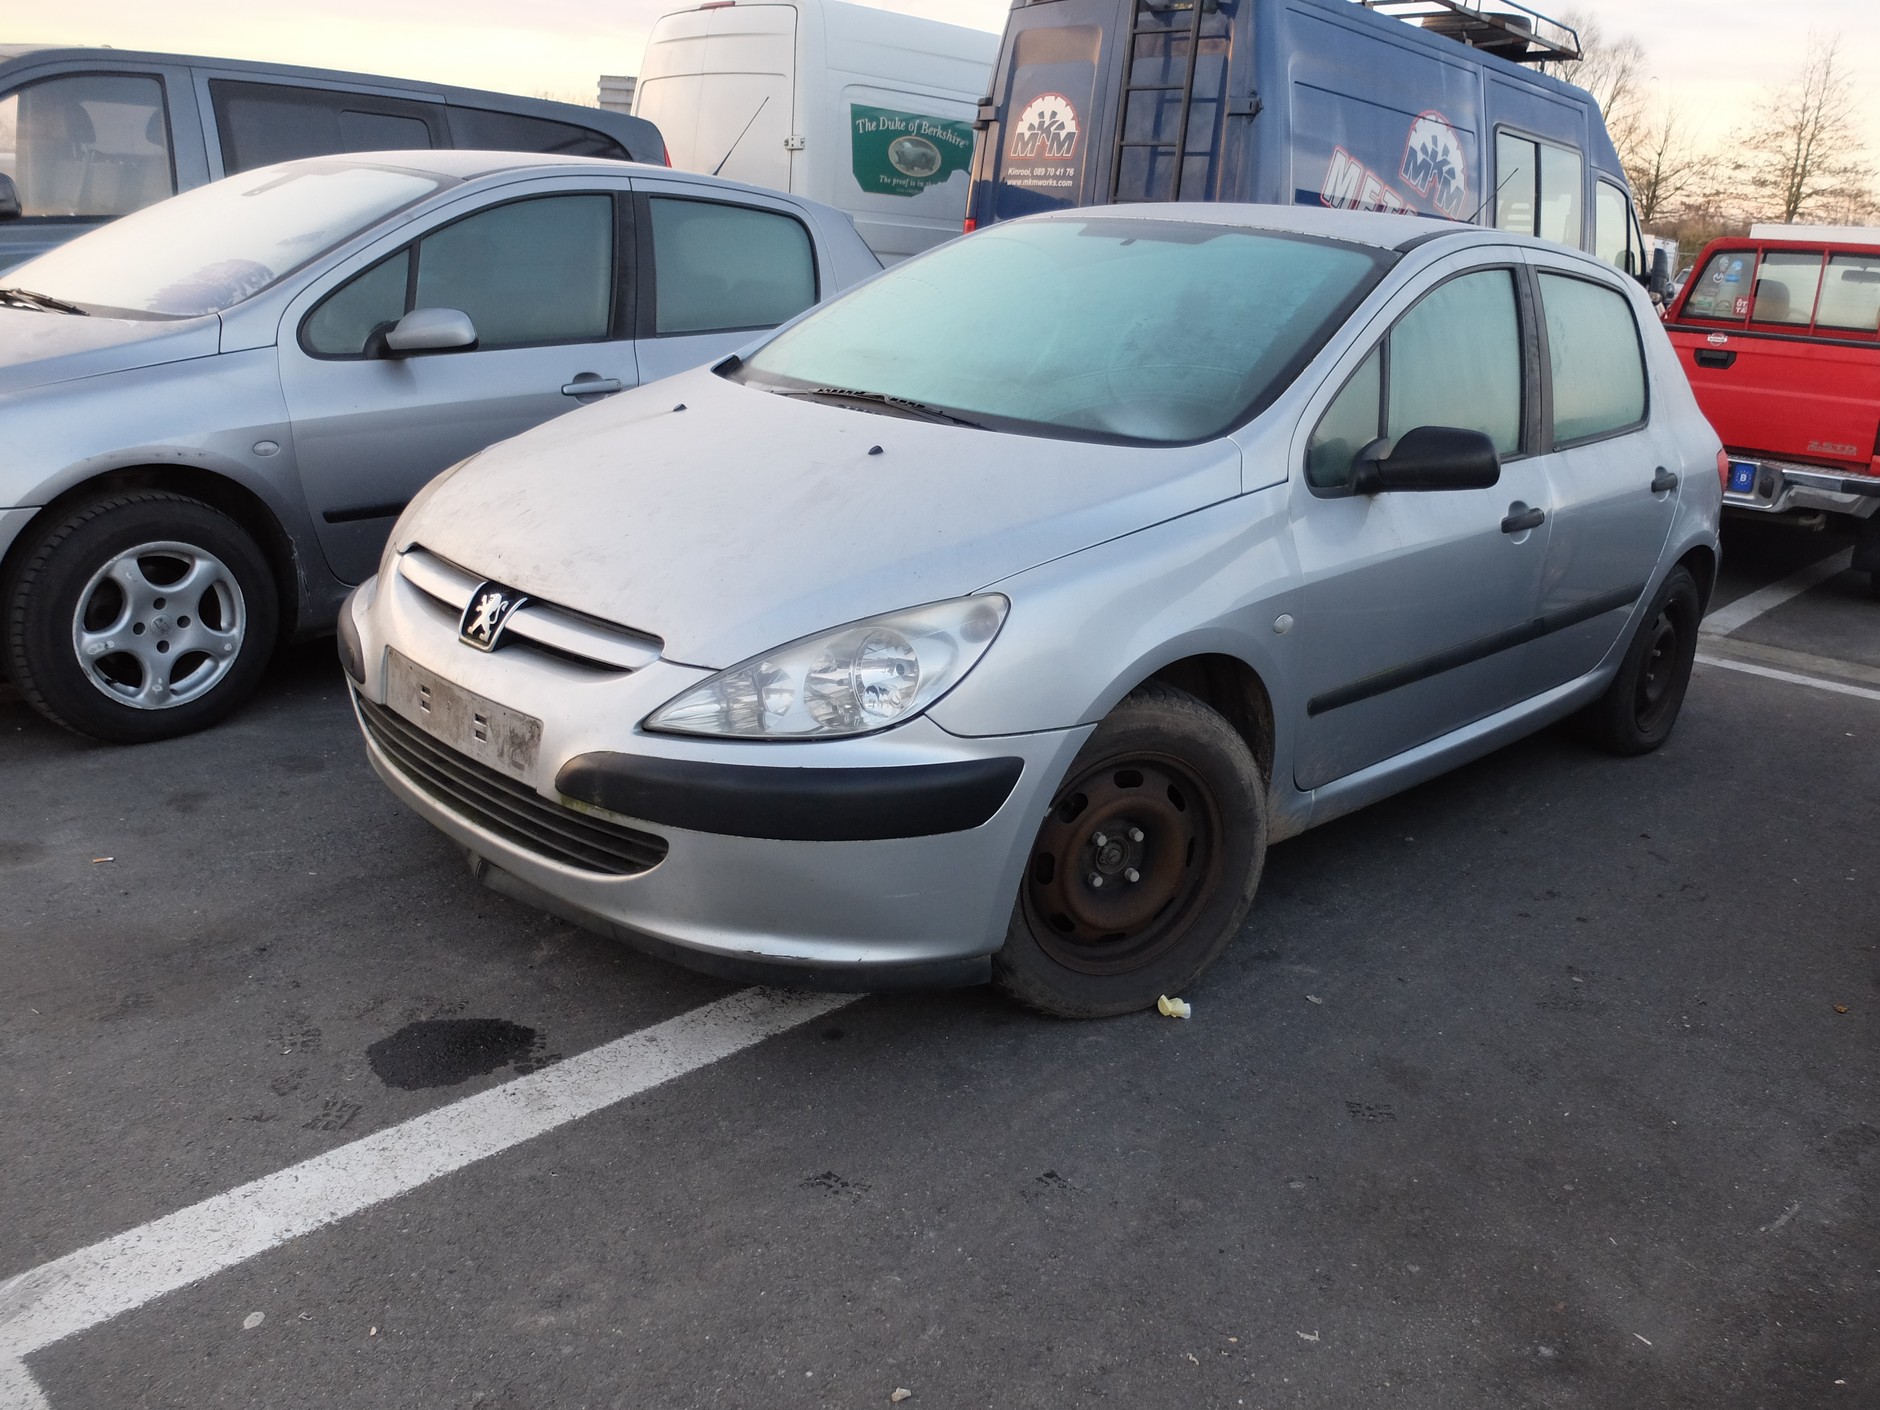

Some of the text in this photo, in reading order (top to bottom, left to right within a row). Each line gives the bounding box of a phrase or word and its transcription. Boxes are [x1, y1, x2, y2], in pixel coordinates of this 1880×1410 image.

[856, 118, 877, 134] The
[879, 116, 906, 131] Duke
[908, 119, 918, 136] of
[1033, 168, 1045, 177] 089
[1047, 168, 1054, 177] 70
[1056, 169, 1064, 177] 41
[879, 175, 891, 184] The
[892, 178, 910, 188] proof
[1007, 179, 1073, 187] www.mkmworks.com
[1740, 473, 1747, 482] B
